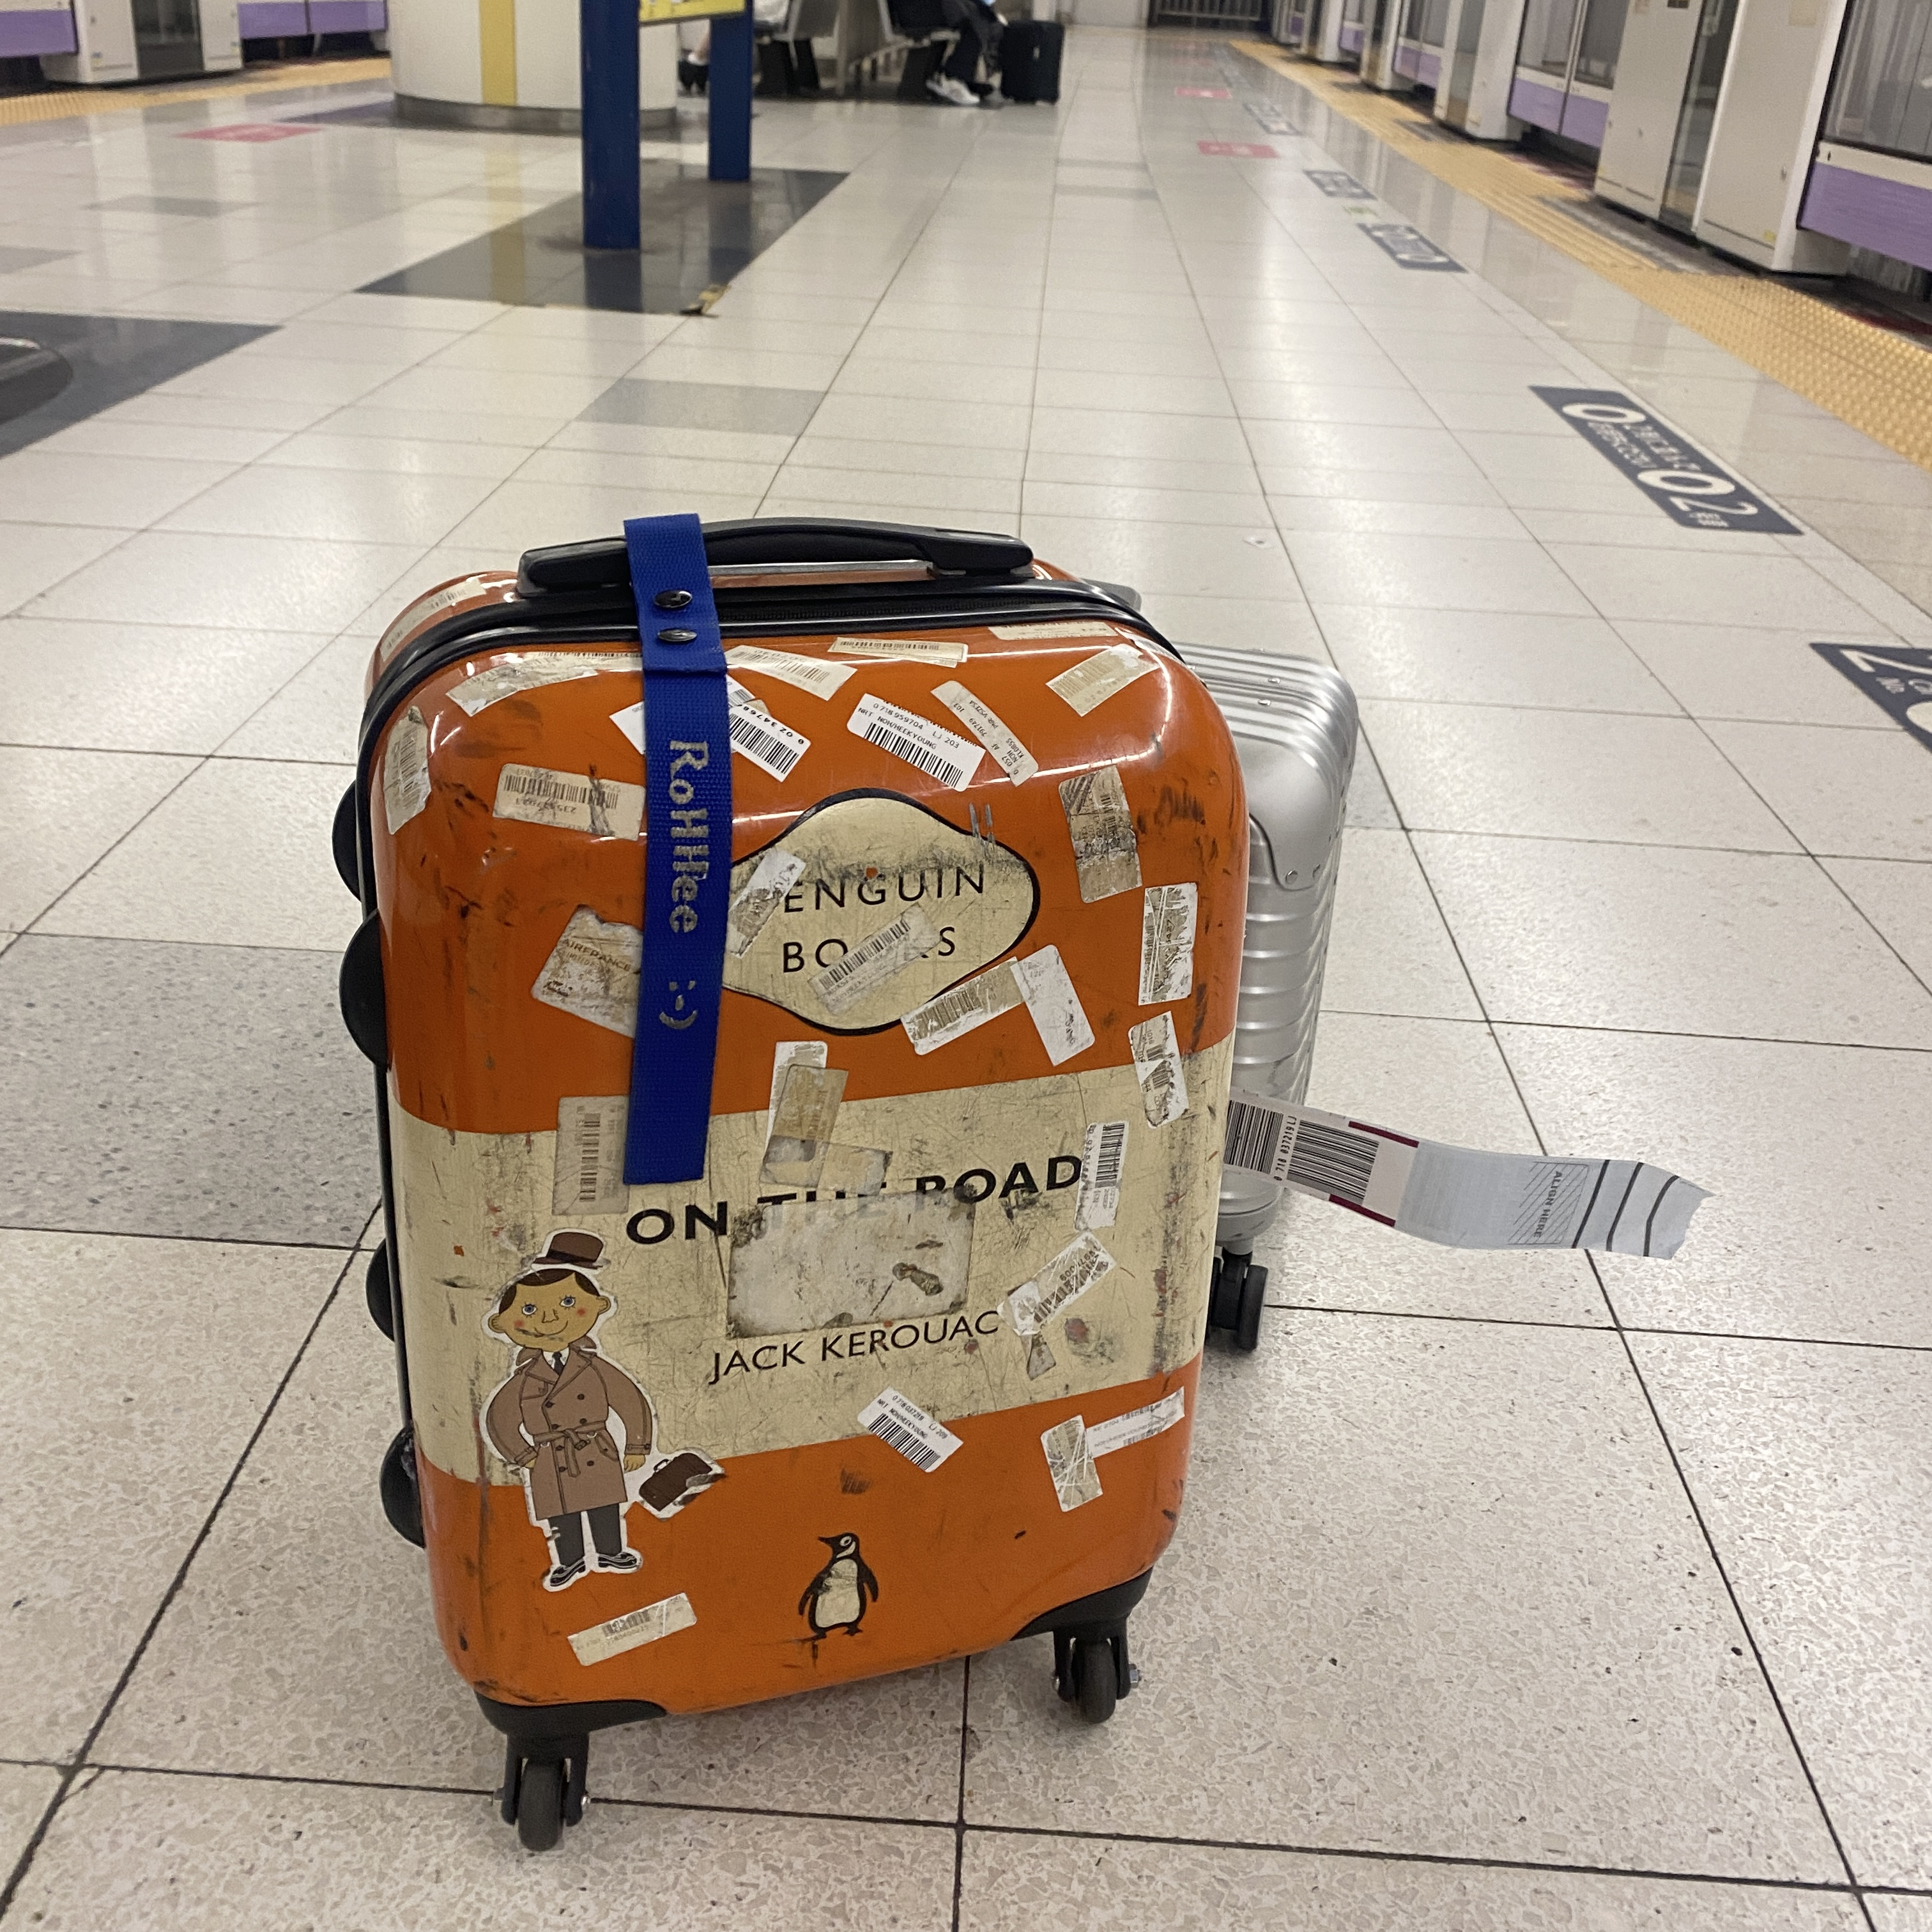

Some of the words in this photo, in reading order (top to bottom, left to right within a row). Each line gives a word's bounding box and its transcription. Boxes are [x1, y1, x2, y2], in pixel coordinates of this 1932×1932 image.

[944, 737, 960, 749] 203
[1006, 749, 1018, 763] NOH
[784, 863, 983, 913] ENGUIN
[783, 926, 955, 973] BOS
[1275, 1157, 1287, 1172] 718
[1544, 1170, 1563, 1207] ALIGN
[625, 1201, 728, 1245] ON
[1533, 1207, 1550, 1239] HERE
[708, 1342, 805, 1385] JACK
[822, 1310, 999, 1363] KEROUAC
